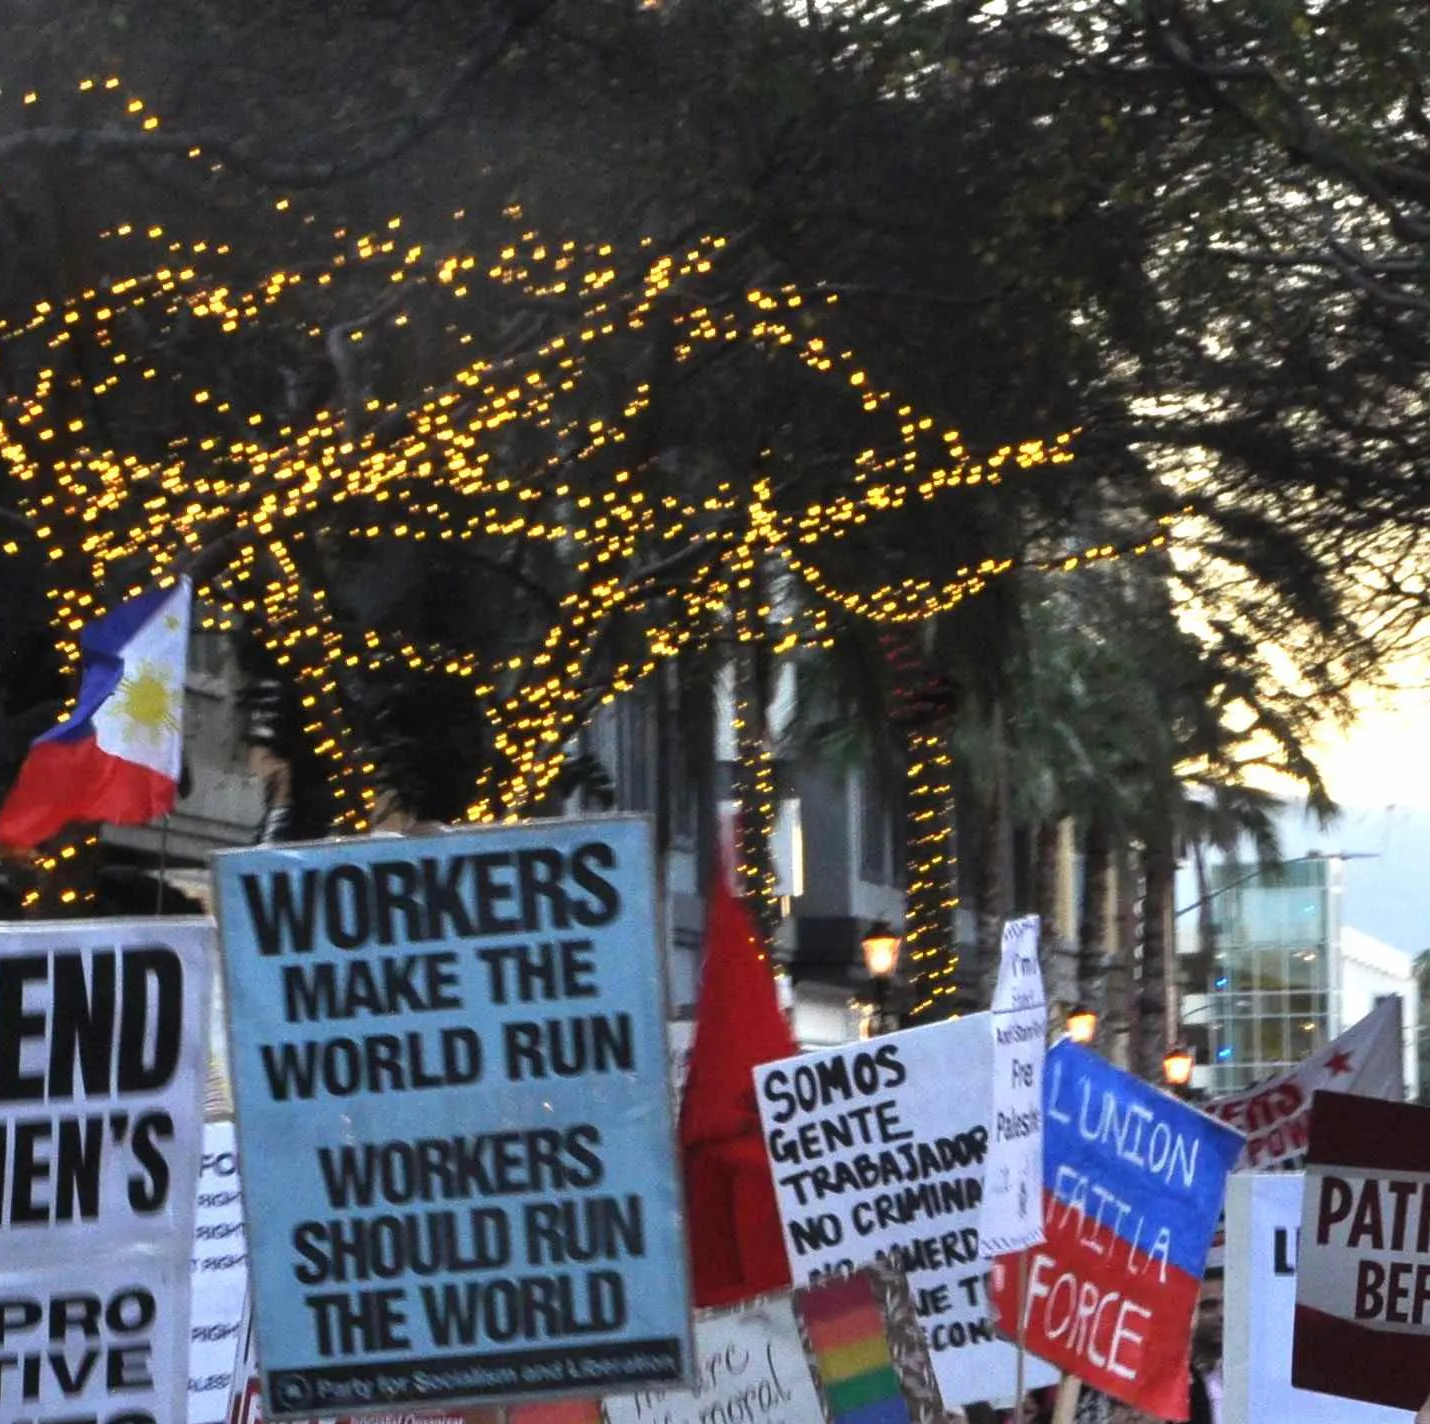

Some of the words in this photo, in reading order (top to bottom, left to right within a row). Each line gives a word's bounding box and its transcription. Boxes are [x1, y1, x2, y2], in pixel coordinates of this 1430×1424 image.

[240, 841, 621, 956] WORKERS
[282, 950, 464, 1023] MAKE
[477, 939, 600, 1005] THE
[260, 1026, 482, 1101] WORLD
[503, 1012, 635, 1081] RUN
[764, 1044, 907, 1123] SOMOS
[318, 1125, 604, 1208] WORKERS
[771, 1100, 915, 1164] GENTE
[780, 1125, 988, 1206] TRABAJADOR
[292, 1204, 511, 1286] SHOULD
[525, 1194, 646, 1266] RUN
[788, 1214, 843, 1255] NO
[1045, 1165, 1131, 1260] FAIT
[305, 1285, 411, 1358] THE
[420, 1270, 627, 1348] WORLD
[1023, 1254, 1152, 1381] FORCE
